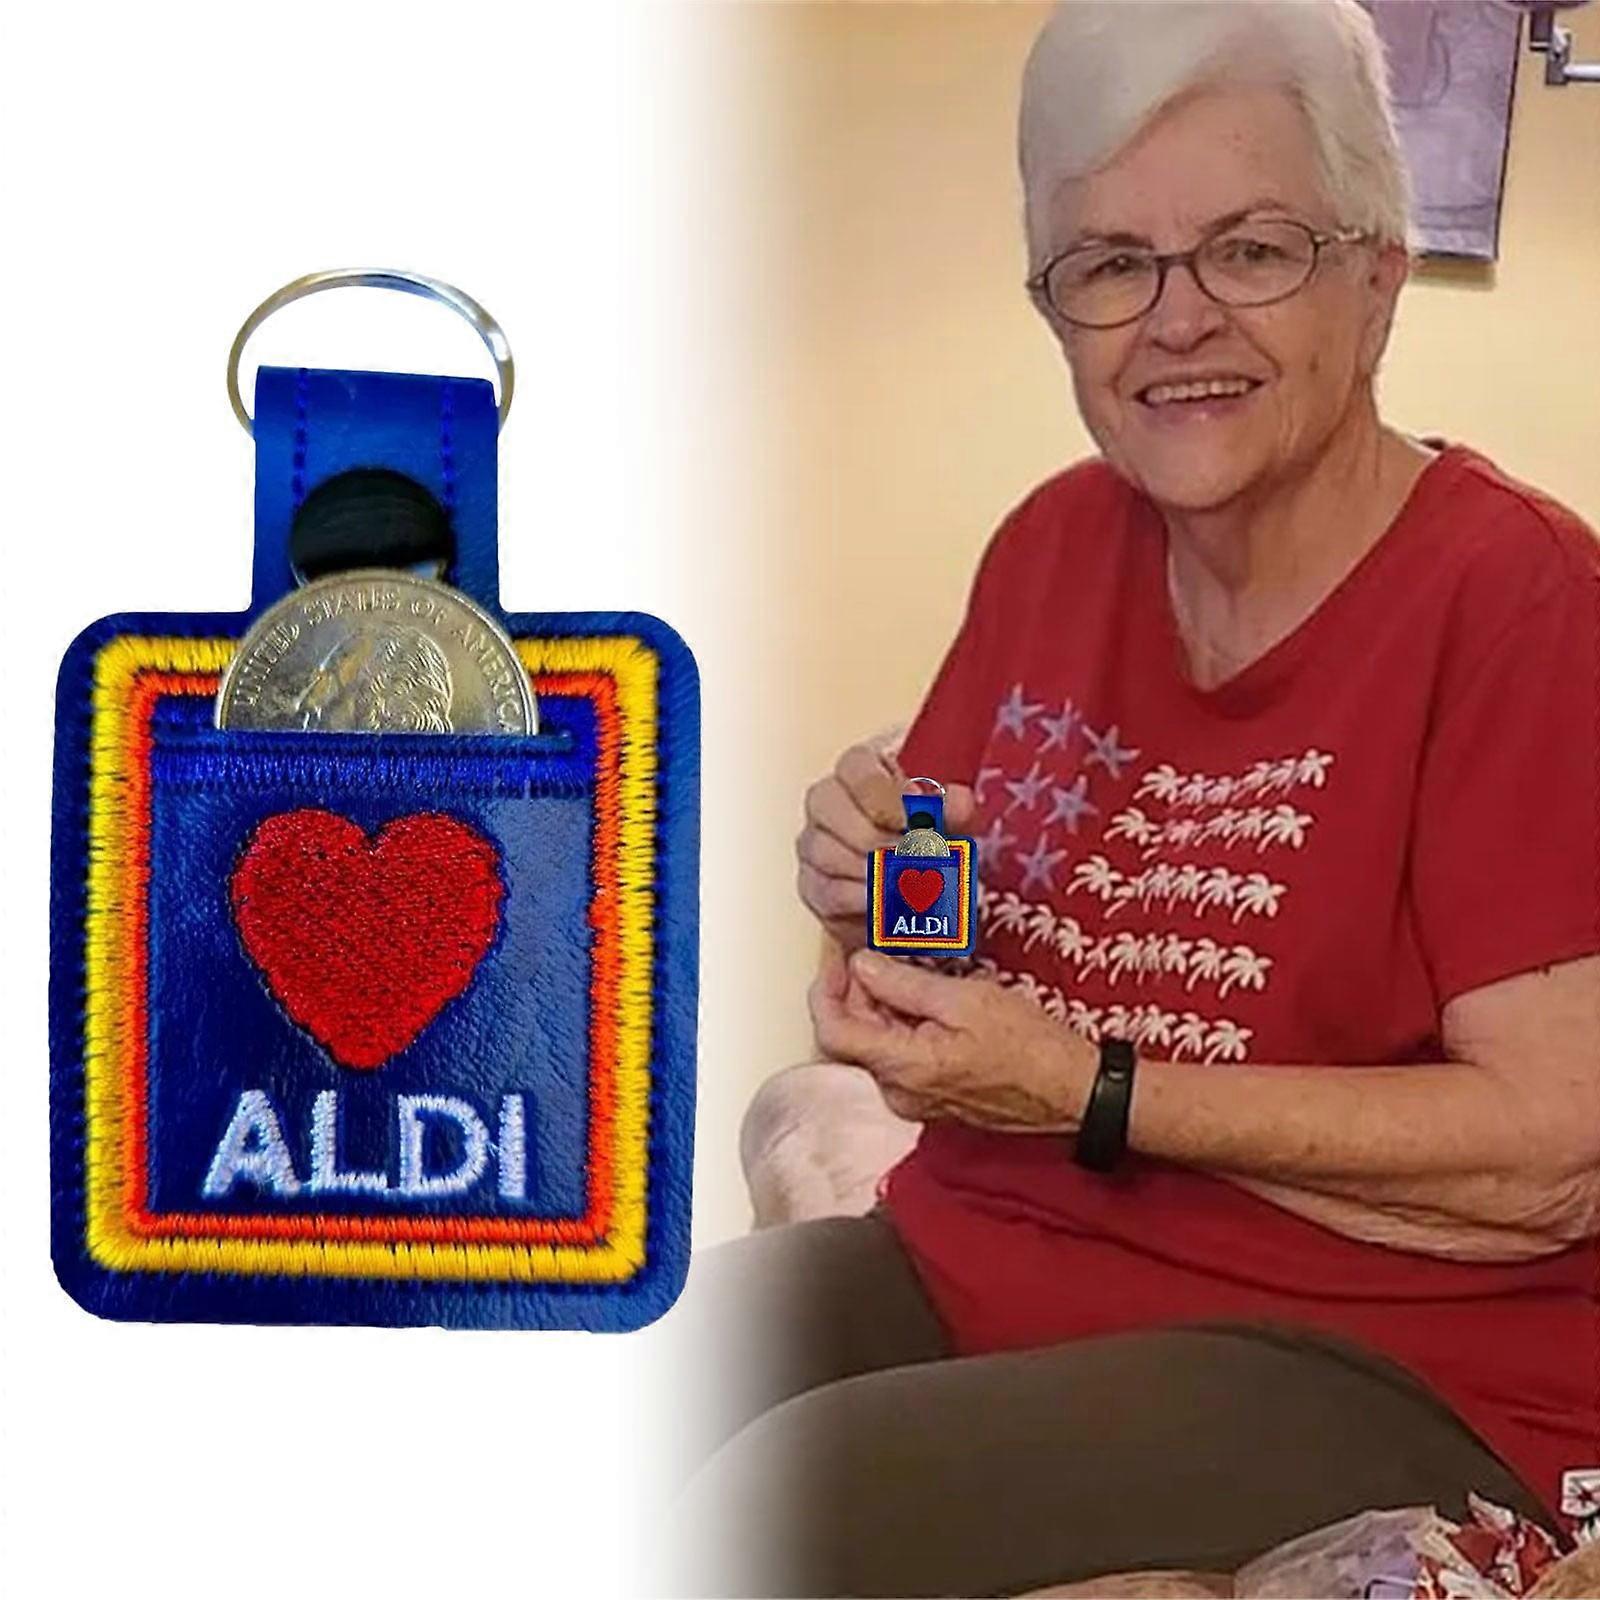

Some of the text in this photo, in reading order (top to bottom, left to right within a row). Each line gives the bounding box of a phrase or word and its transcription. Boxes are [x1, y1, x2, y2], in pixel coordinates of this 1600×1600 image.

[232, 623, 300, 707] UNITED
[303, 590, 402, 627] STATES
[410, 601, 449, 626] OF
[892, 915, 948, 936] ALDI
[202, 1089, 526, 1199] ALDI
